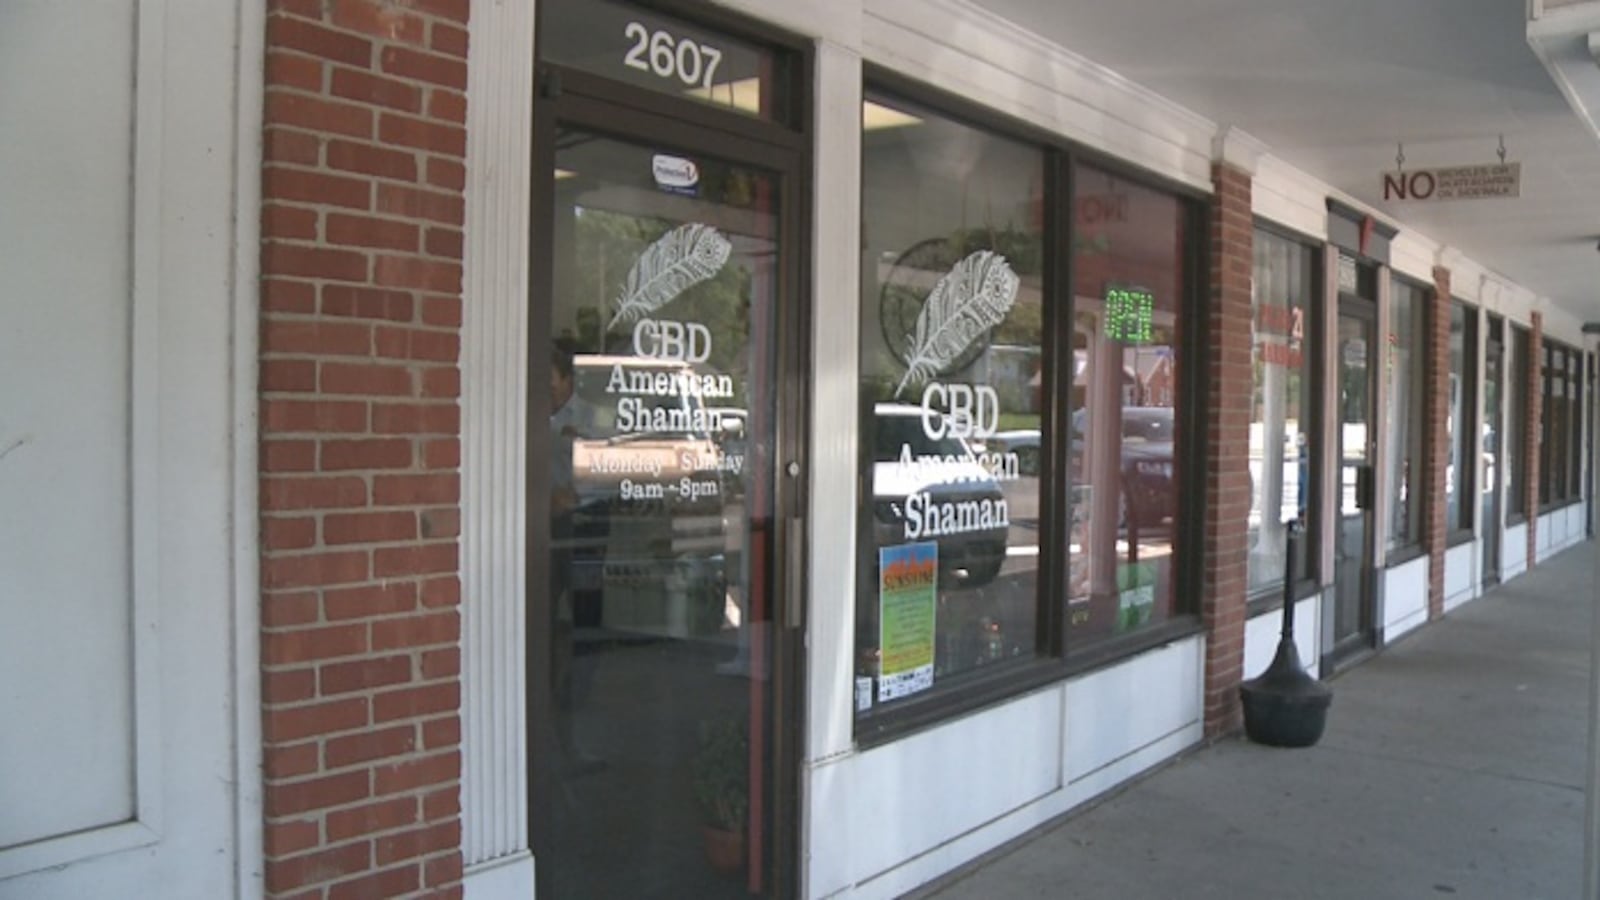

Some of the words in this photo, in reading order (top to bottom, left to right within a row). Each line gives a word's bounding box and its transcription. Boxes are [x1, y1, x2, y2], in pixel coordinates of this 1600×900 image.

[624, 22, 722, 89] 2607
[1383, 171, 1435, 200] NO
[1104, 289, 1153, 341] OPEN
[633, 318, 712, 364] CBD
[606, 364, 734, 400] American
[617, 397, 723, 433] Shaman
[922, 382, 1000, 440] CBD
[589, 452, 663, 477] Monday
[680, 450, 744, 475] Sunday
[896, 443, 1020, 484] American
[904, 493, 1010, 540] Shaman
